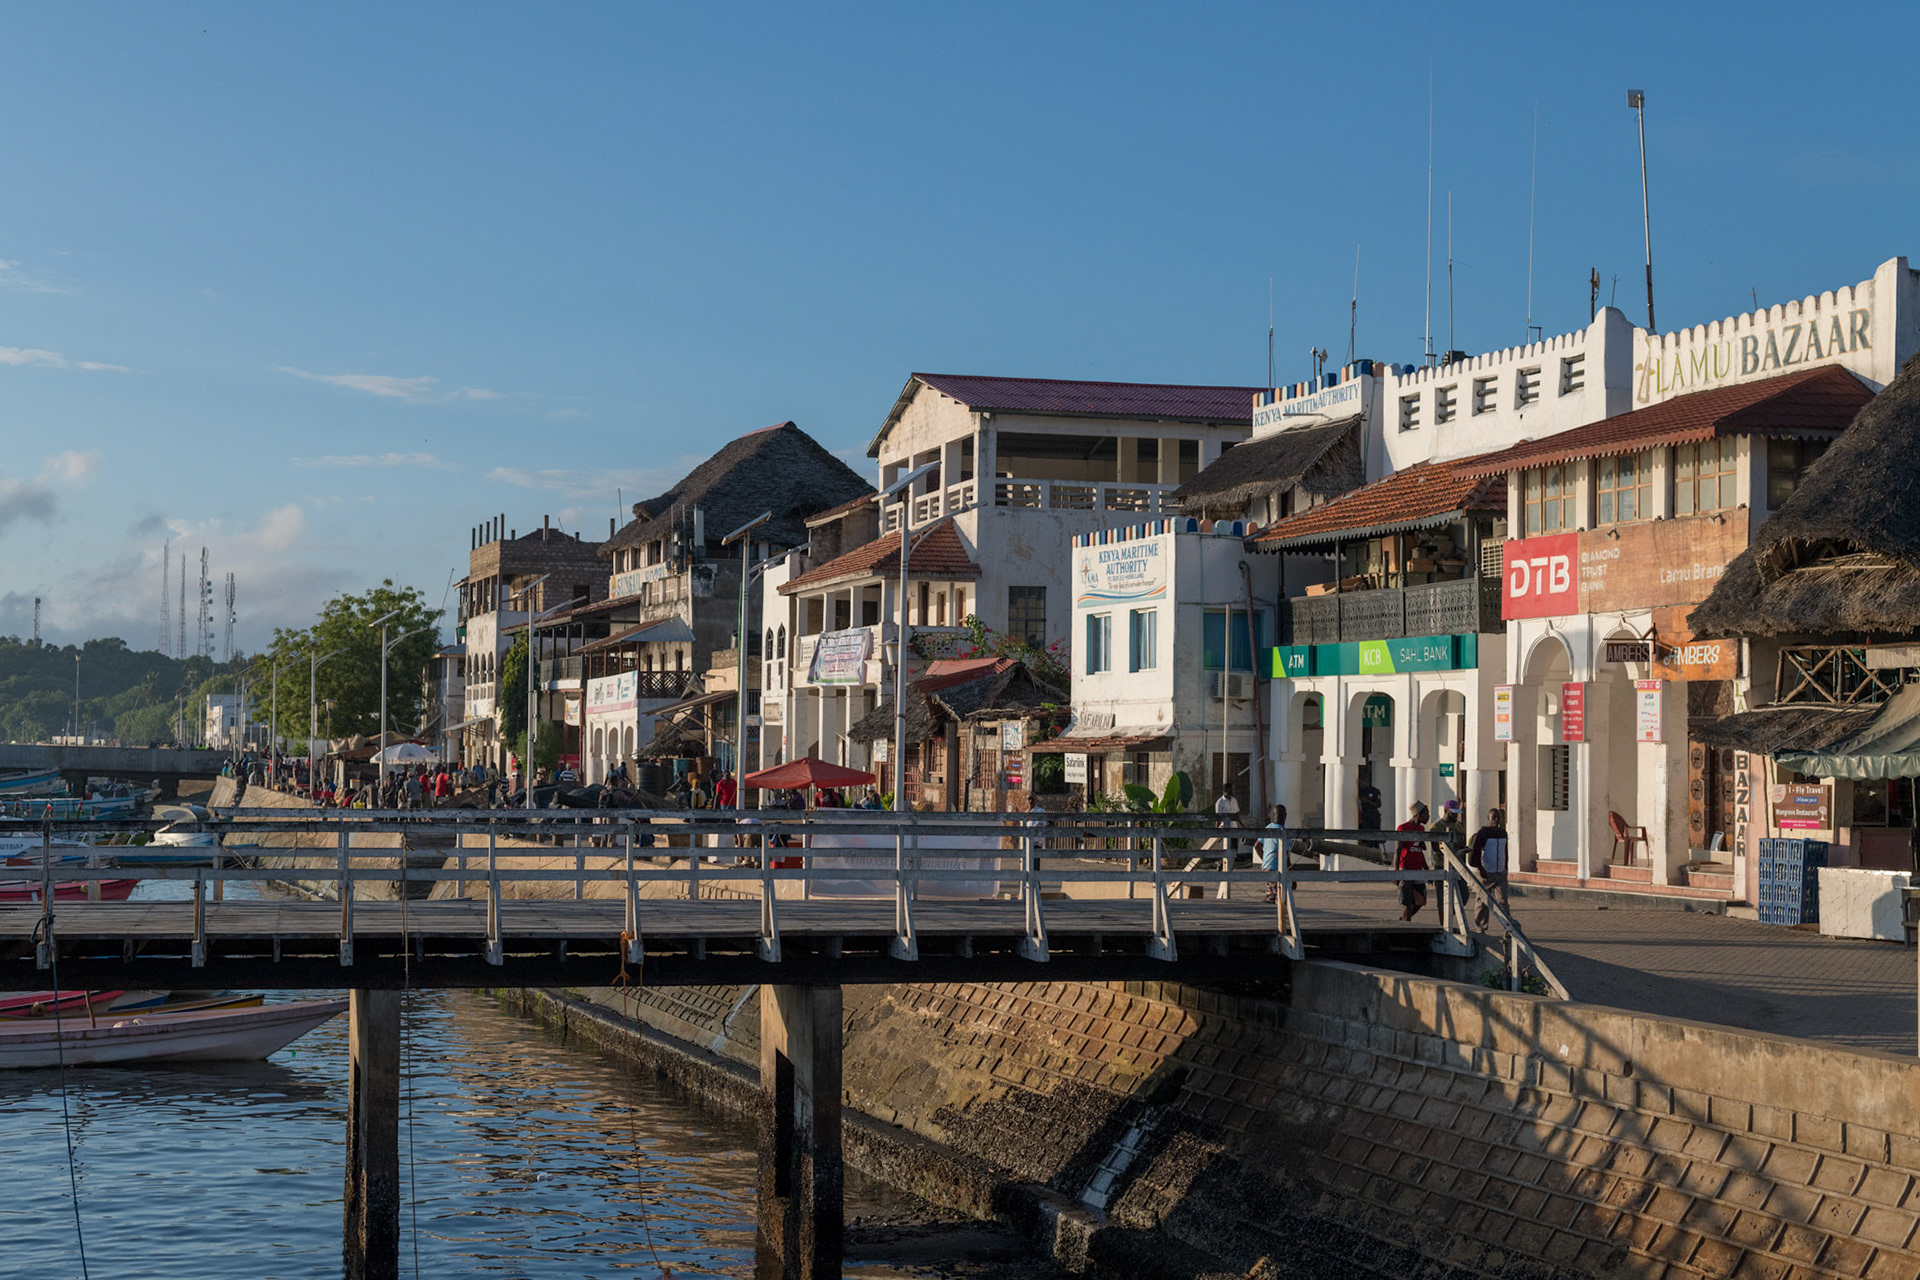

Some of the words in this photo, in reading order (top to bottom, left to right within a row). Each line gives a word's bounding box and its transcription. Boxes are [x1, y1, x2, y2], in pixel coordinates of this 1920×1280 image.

[1656, 341, 1731, 393] LAMU
[1740, 308, 1873, 376] BAZAAR
[1254, 408, 1282, 428] KENYA
[1318, 383, 1360, 409] AUTHORITY
[1099, 550, 1120, 564] KENYA
[1121, 543, 1158, 560] MARITIME
[1581, 548, 1620, 563] DIAMOND
[1106, 559, 1148, 575] AUTHORITY
[1582, 565, 1607, 577] TRUST
[1510, 555, 1570, 598] DTB
[1660, 567, 1691, 584] Lamu
[1581, 581, 1604, 592] BANK
[1288, 654, 1305, 669] ATM
[1364, 649, 1381, 666] KCB
[1424, 646, 1448, 662] BANK
[1607, 646, 1649, 662] AMBERS
[1663, 645, 1720, 667] AMBERS
[1806, 786, 1824, 794] Travel
